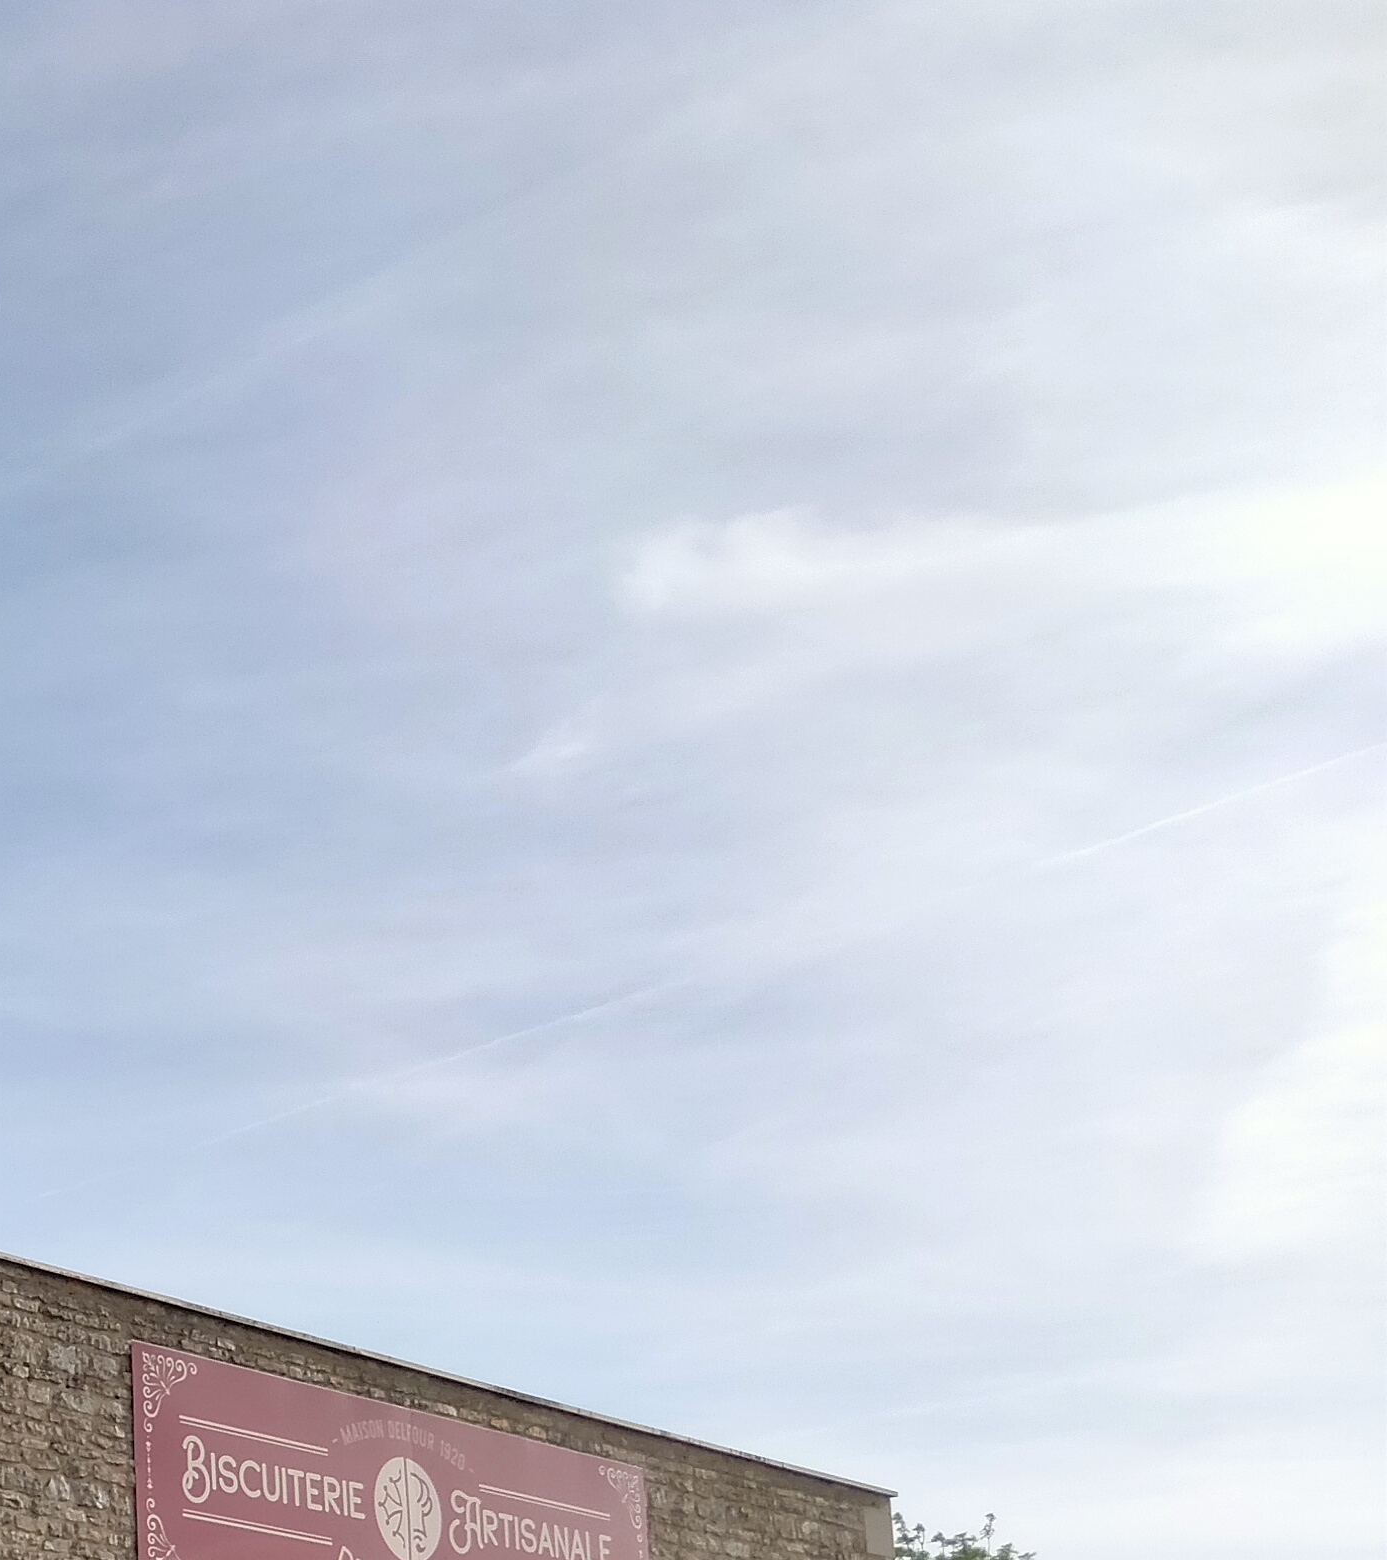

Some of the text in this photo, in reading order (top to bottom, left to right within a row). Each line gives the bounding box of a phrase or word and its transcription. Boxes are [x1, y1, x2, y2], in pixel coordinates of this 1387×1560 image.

[182, 1435, 366, 1520] BISCUITERIE
[339, 1419, 466, 1471] MAISON DELFOUR 1920
